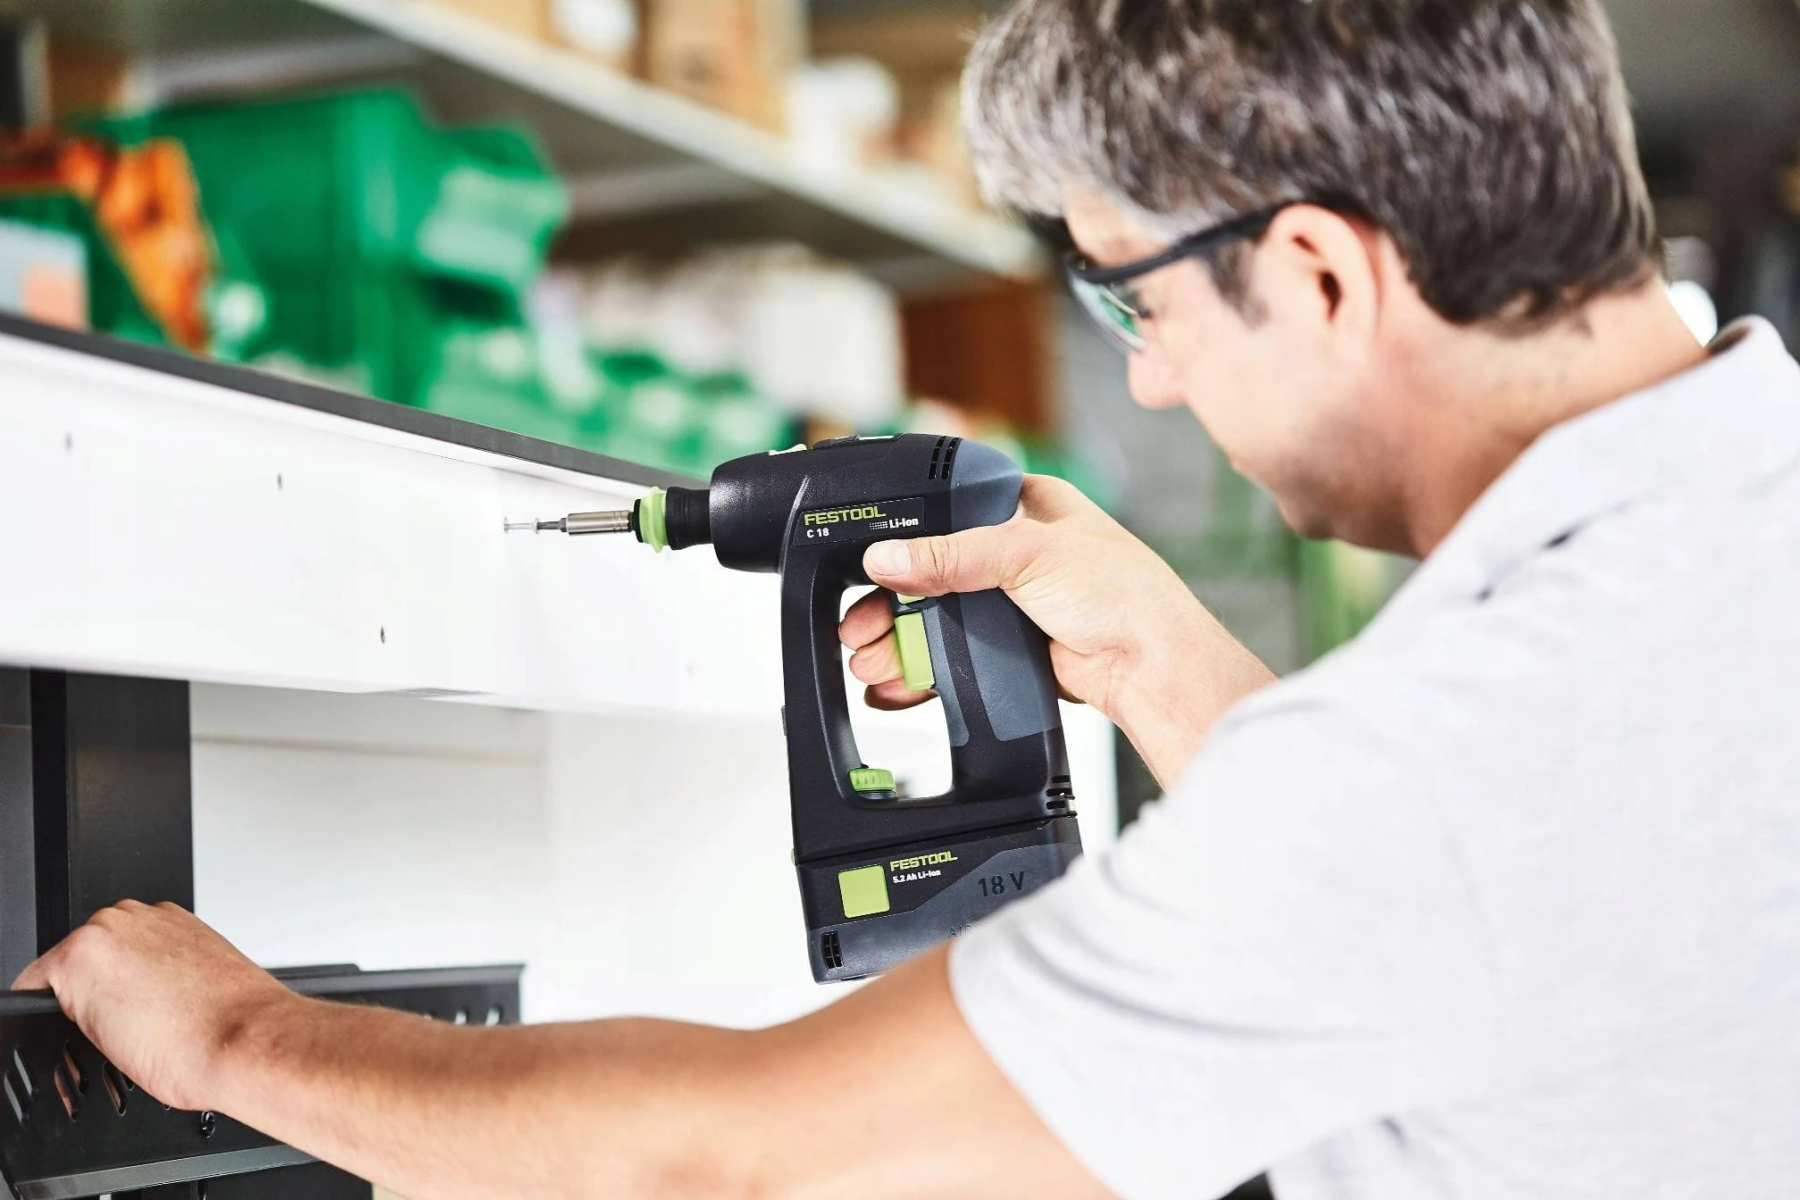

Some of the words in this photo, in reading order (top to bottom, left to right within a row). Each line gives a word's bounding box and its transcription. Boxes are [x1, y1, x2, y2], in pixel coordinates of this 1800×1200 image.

[804, 506, 886, 526] FESTOOL
[889, 518, 919, 529] Li-Ion
[806, 530, 815, 538] C
[817, 528, 830, 537] 18
[890, 851, 958, 871] FESTOOL
[893, 875, 905, 883] 5.2
[906, 873, 917, 881] Ah
[978, 876, 1005, 897] 18
[1009, 871, 1025, 891] V
